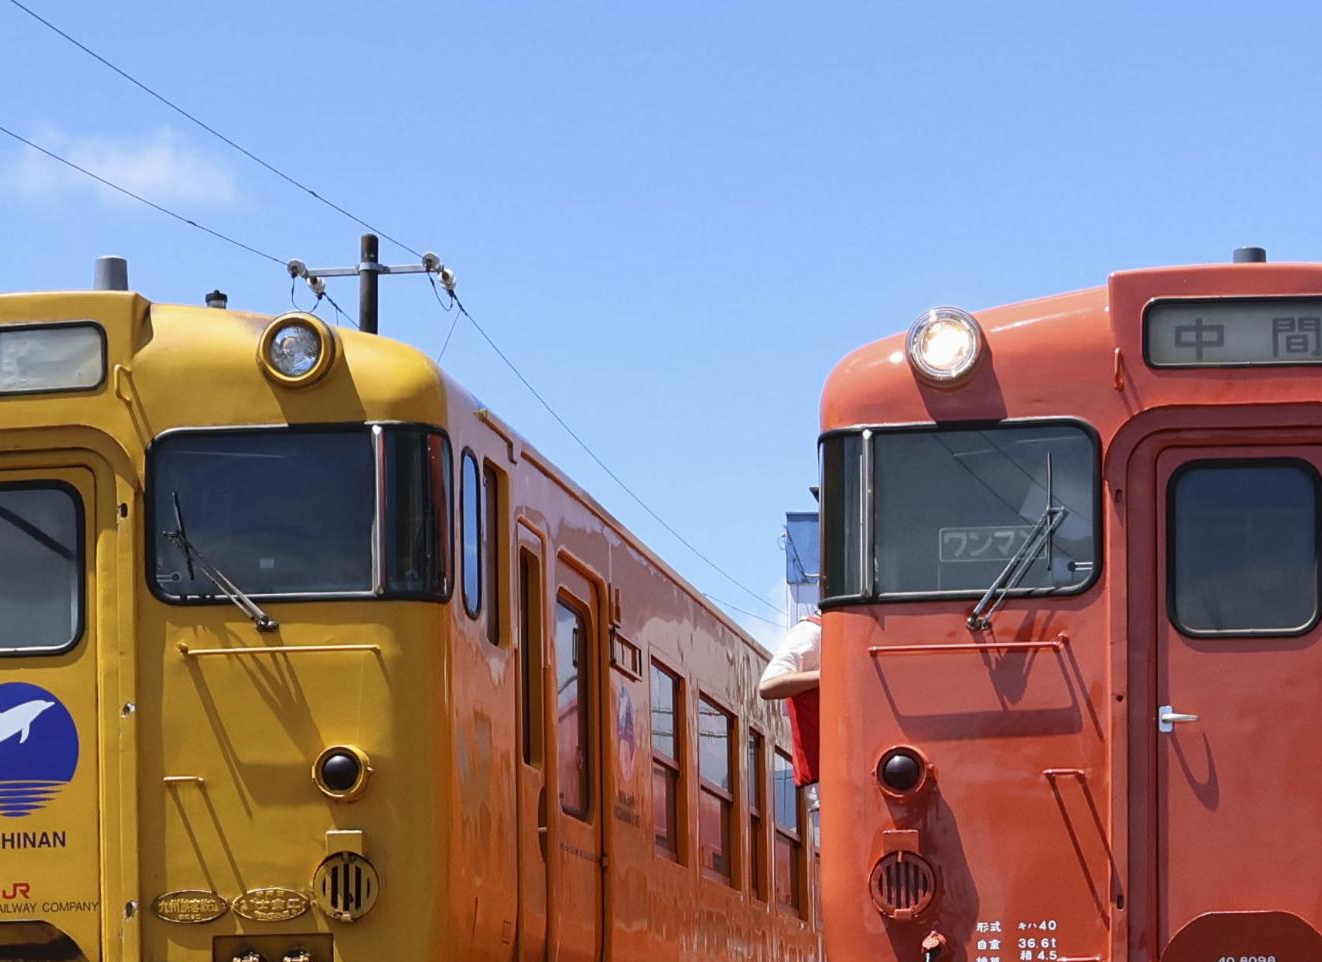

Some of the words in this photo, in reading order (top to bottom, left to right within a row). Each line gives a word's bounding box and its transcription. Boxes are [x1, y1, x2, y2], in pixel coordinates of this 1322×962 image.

[1174, 317, 1322, 360] 中間
[2, 882, 30, 899] JR
[42, 901, 99, 913] COMPANY
[976, 921, 1002, 932] 形式
[1018, 920, 1057, 931] キハ40
[1018, 938, 1057, 949] 36.6t
[1037, 950, 1057, 961] 4.5
